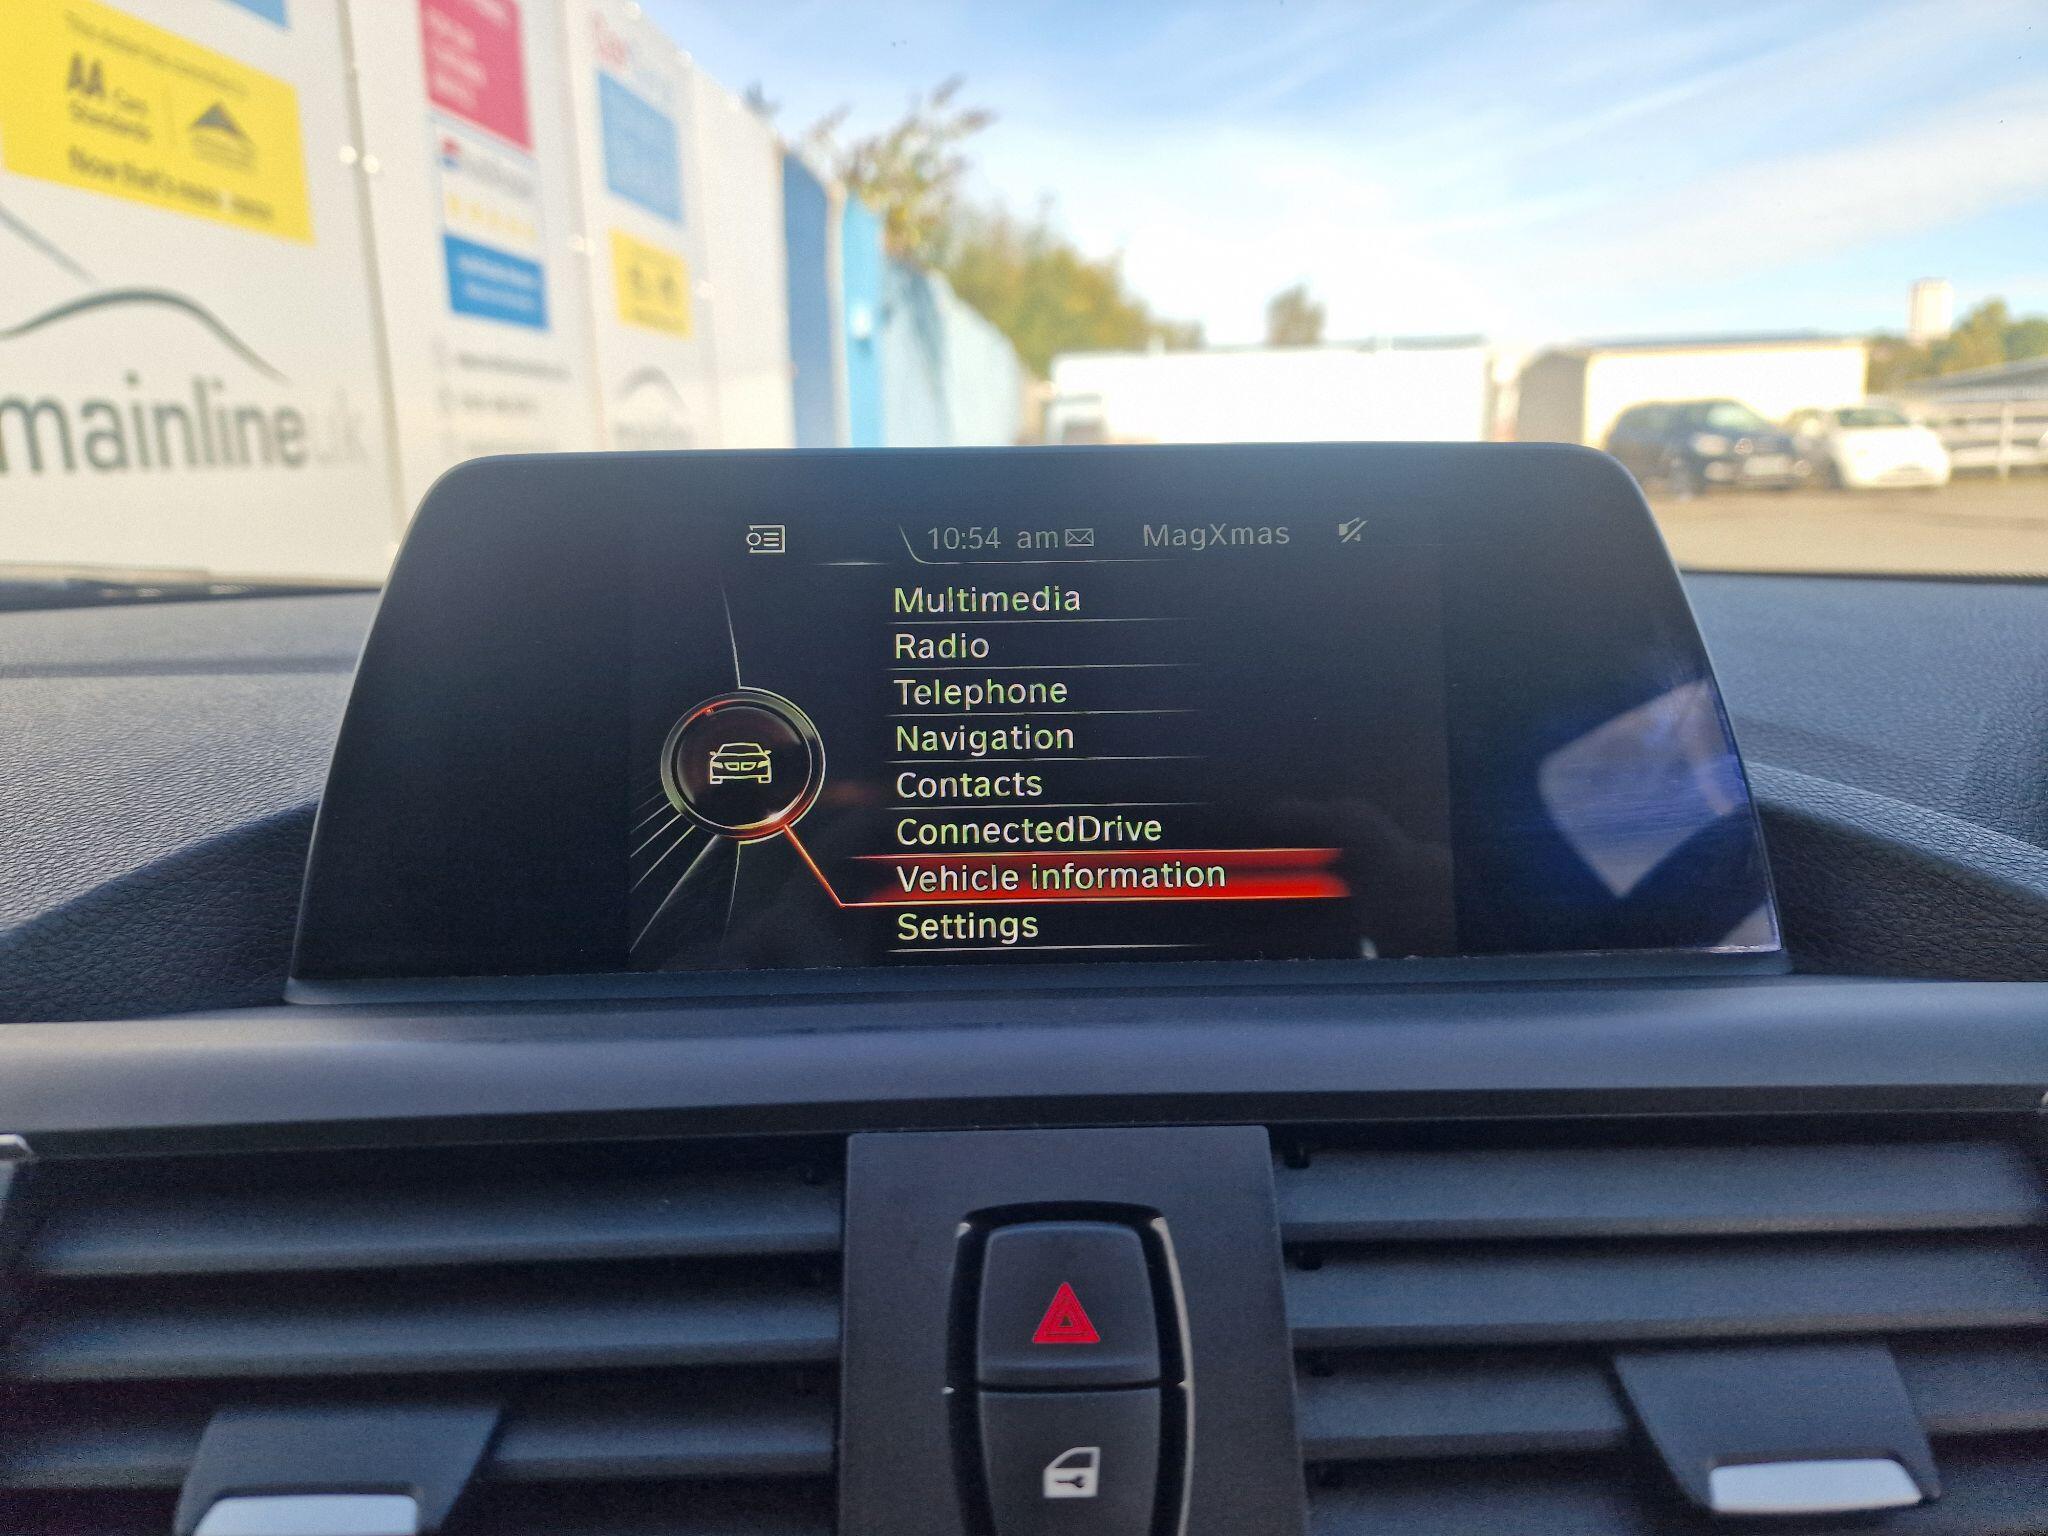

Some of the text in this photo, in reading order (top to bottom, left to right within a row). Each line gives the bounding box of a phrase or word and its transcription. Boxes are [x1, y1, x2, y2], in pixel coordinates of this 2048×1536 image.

[926, 523, 1290, 551] 10:54 am MagXmas
[894, 585, 1081, 613] Multimedia
[895, 632, 990, 659] Radio
[894, 679, 1068, 710] Telephone
[896, 725, 1075, 757] Navigation
[897, 771, 1043, 799] Contacts
[896, 815, 1162, 846] ConnectedDrive
[896, 862, 1227, 893] Vehicle information
[896, 912, 1039, 945] Settings
